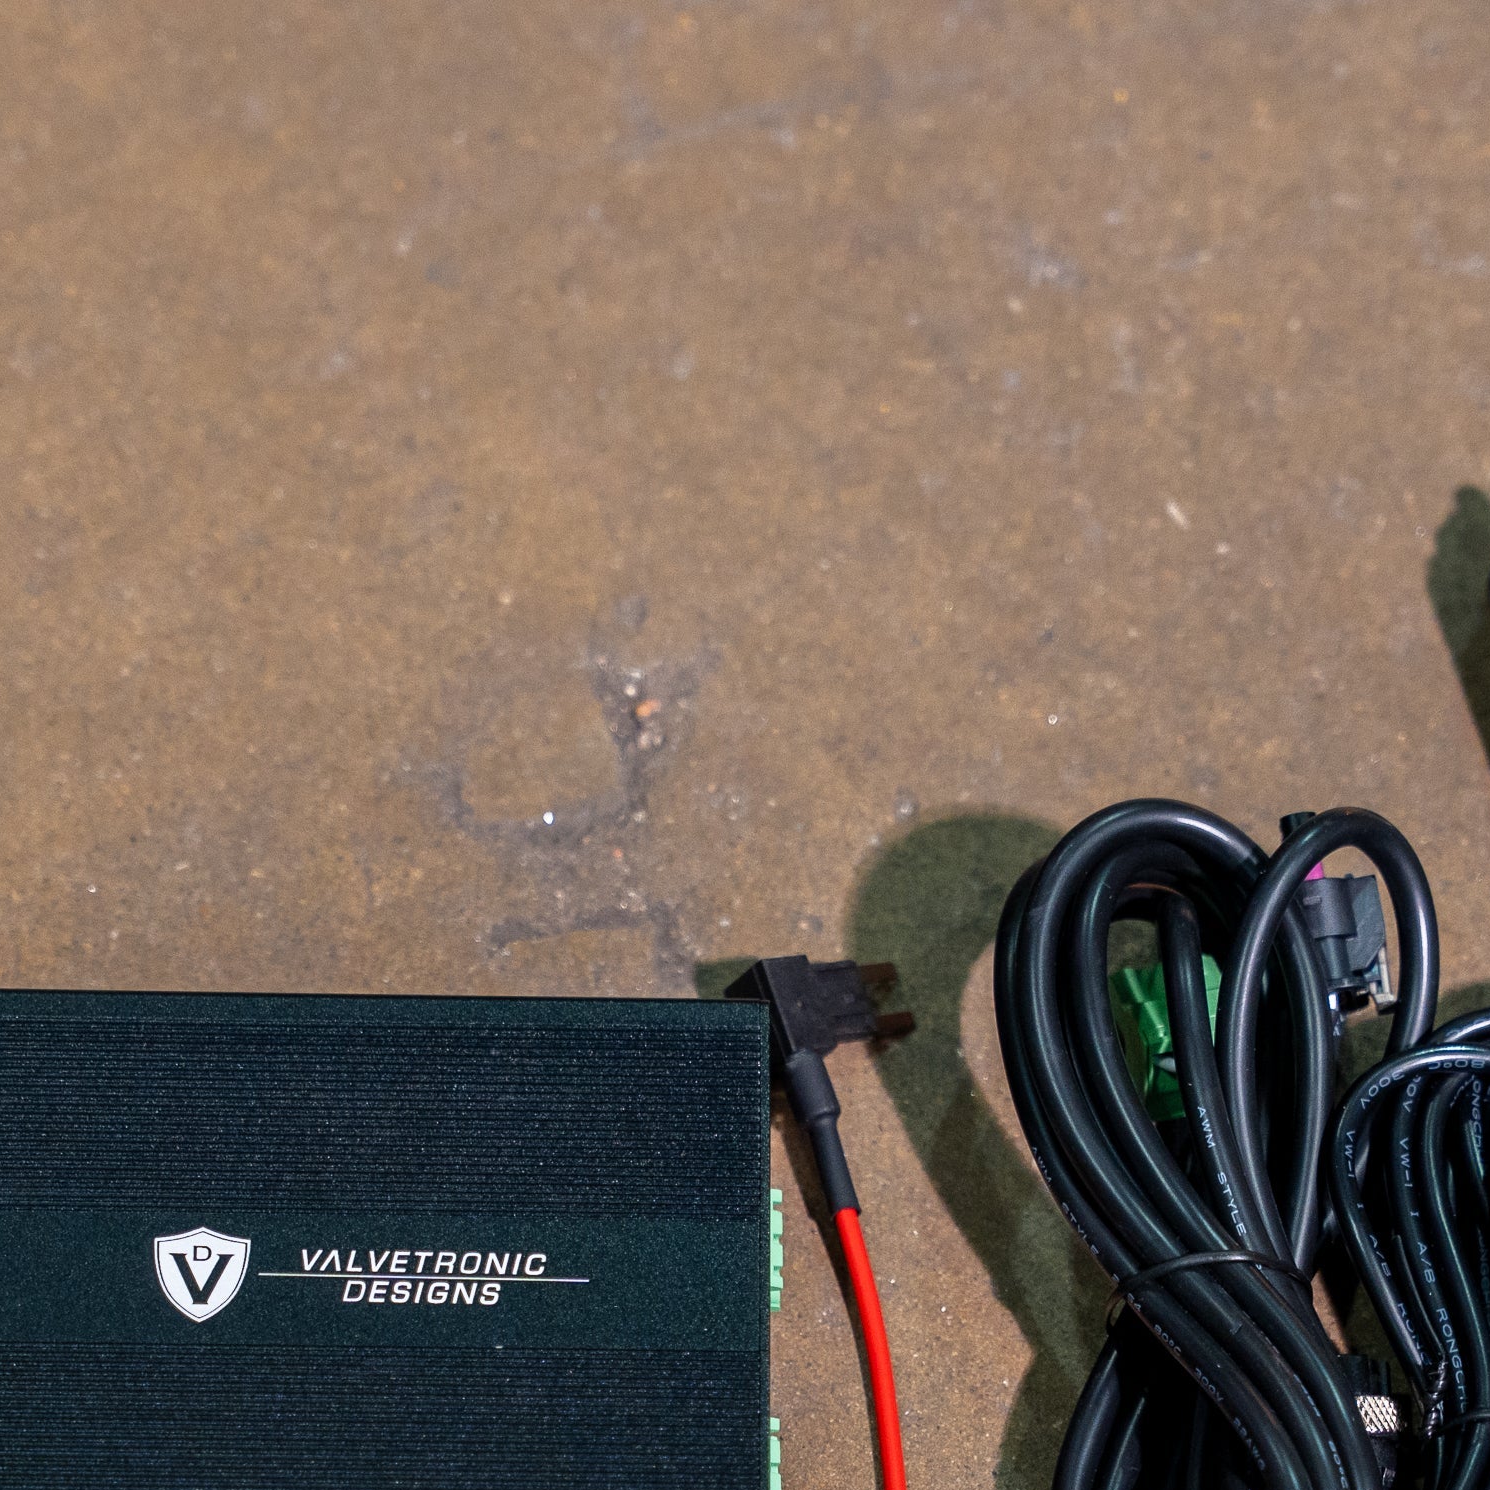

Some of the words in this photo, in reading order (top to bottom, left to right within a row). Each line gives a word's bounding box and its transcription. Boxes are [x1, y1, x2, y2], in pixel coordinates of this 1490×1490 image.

[1360, 1072, 1405, 1111] 300V
[1197, 1106, 1216, 1149] AWM
[1217, 1172, 1247, 1237] STYLE
[300, 1249, 548, 1276] VALVETRONIC
[1369, 1234, 1391, 1278] A/B
[1417, 1241, 1436, 1284] A/B
[342, 1279, 502, 1306] DESIGNS
[1061, 1202, 1100, 1256] STYLE
[1194, 1367, 1224, 1402] 300V
